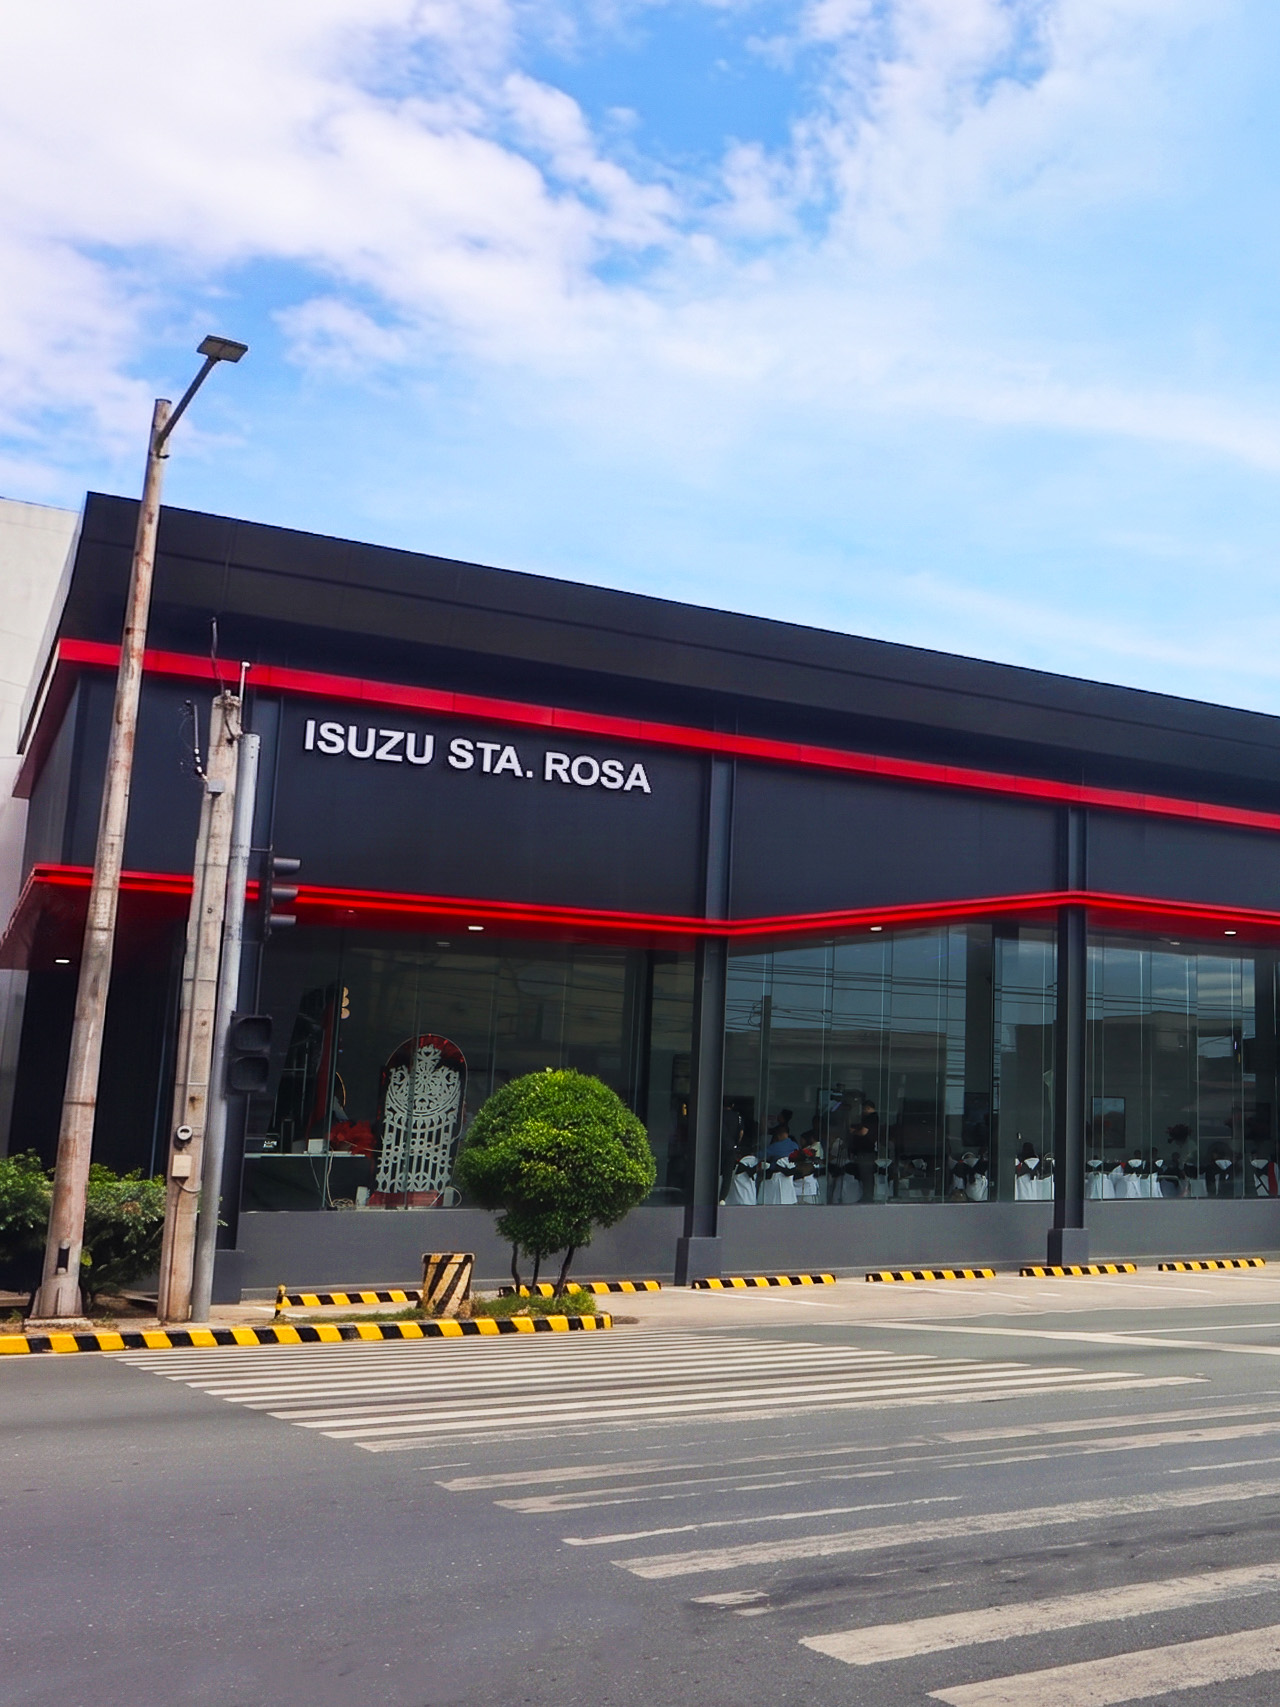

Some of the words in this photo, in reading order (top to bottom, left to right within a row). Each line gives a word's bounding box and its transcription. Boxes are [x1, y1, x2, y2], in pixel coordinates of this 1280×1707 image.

[304, 719, 435, 765] ISUZU
[447, 737, 533, 779] STA.
[544, 751, 652, 794] ROSA
